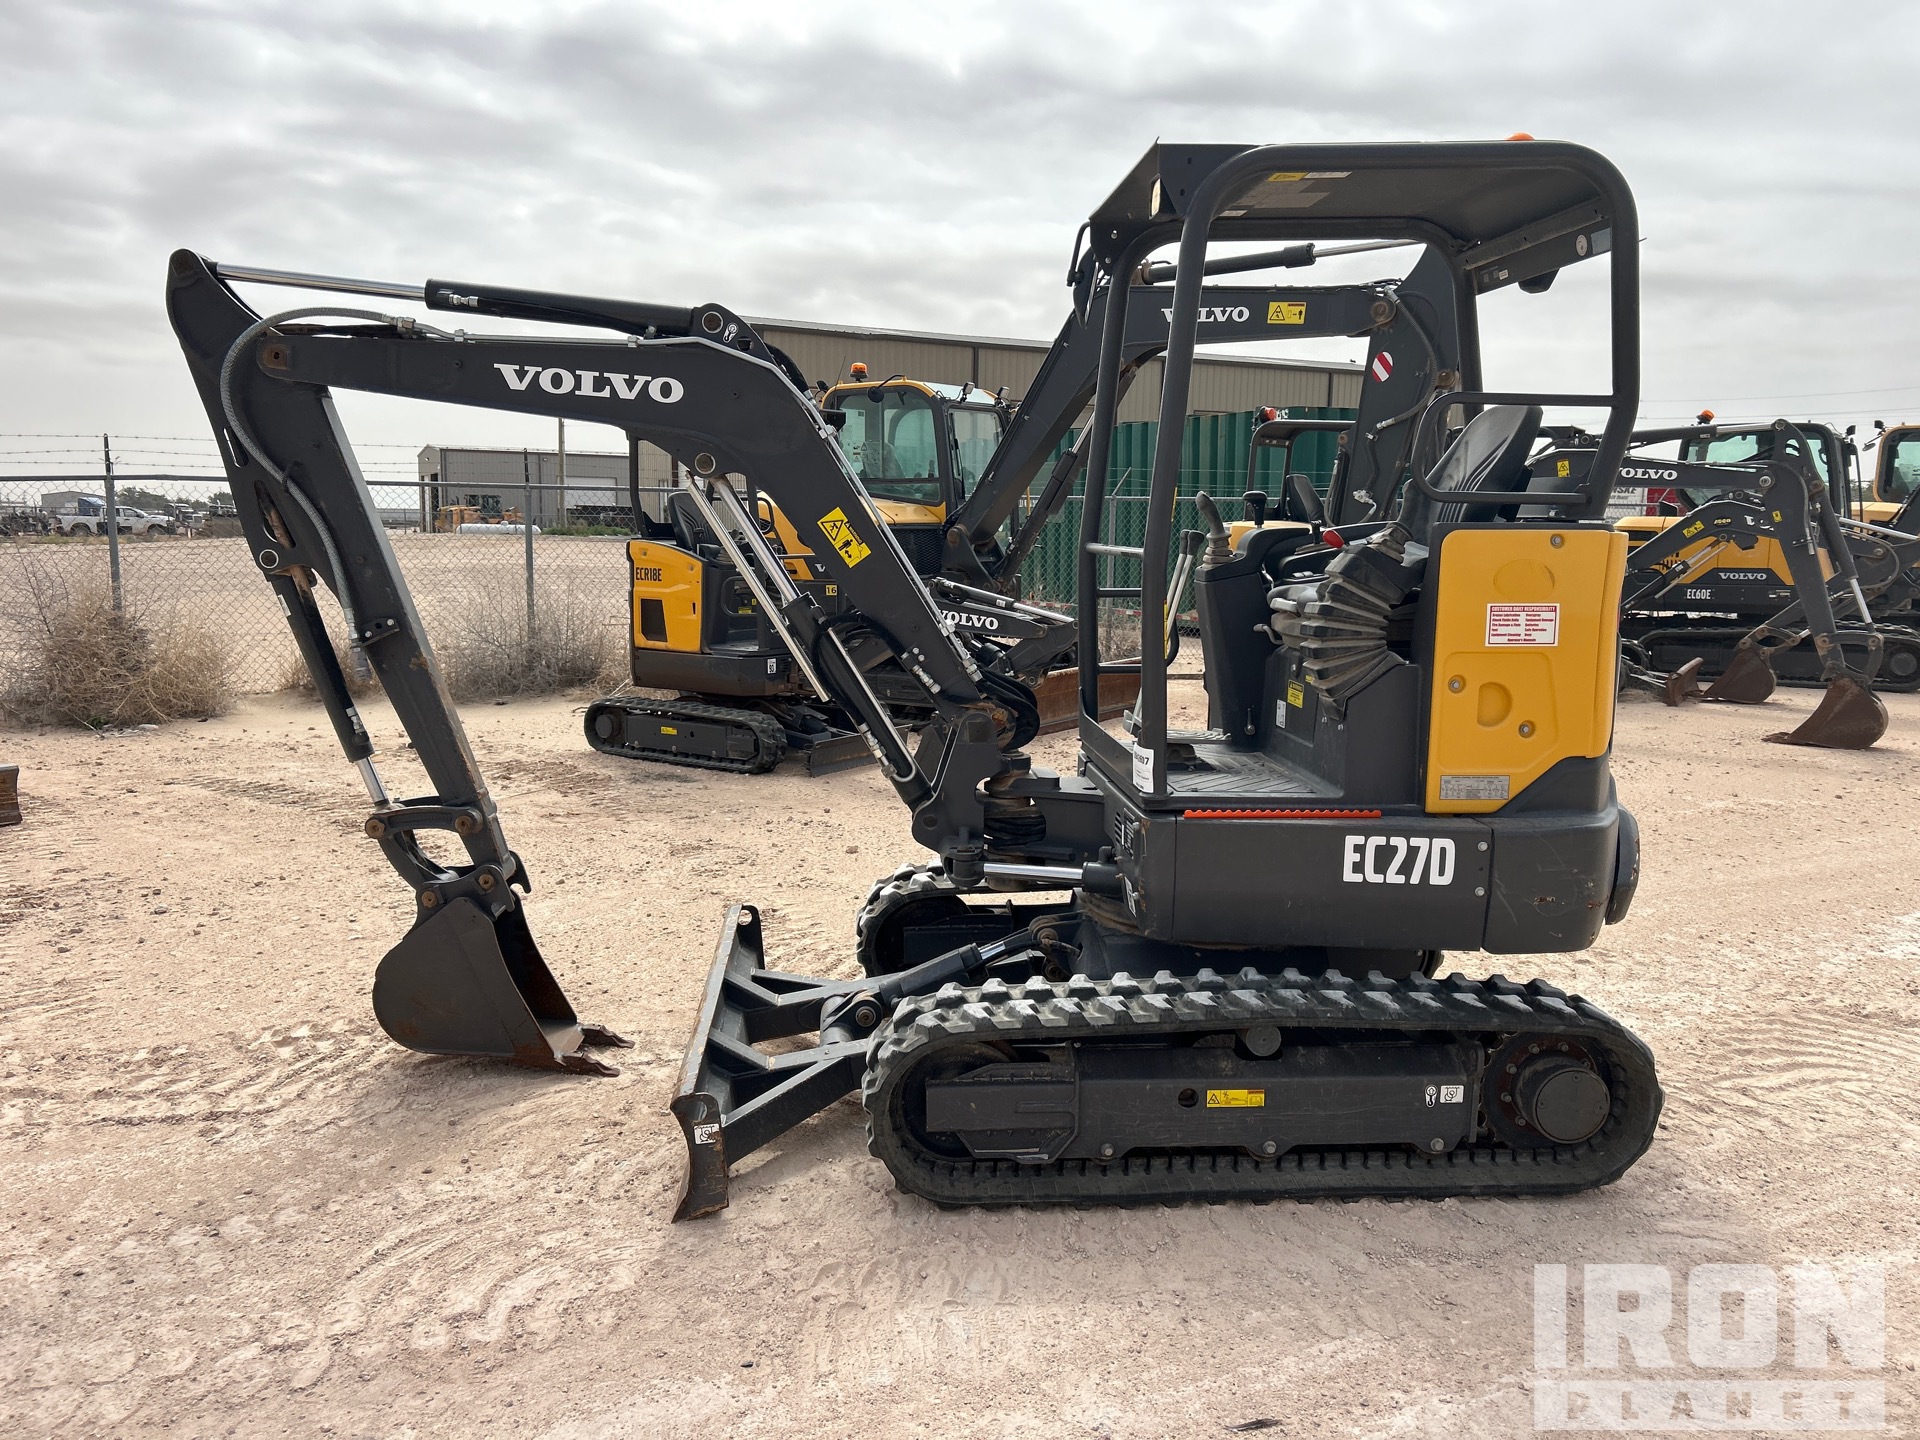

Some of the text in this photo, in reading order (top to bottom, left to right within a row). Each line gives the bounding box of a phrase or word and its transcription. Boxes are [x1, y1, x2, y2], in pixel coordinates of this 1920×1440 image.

[1161, 306, 1250, 323] VLVO
[493, 363, 685, 404] VOLVO
[1619, 467, 1678, 481] OLVO
[635, 567, 663, 582] ECR18E
[1718, 572, 1767, 581] VOLVO
[826, 586, 837, 595] 16
[1686, 588, 1712, 600] EC60E
[1343, 835, 1456, 886] EC27D
